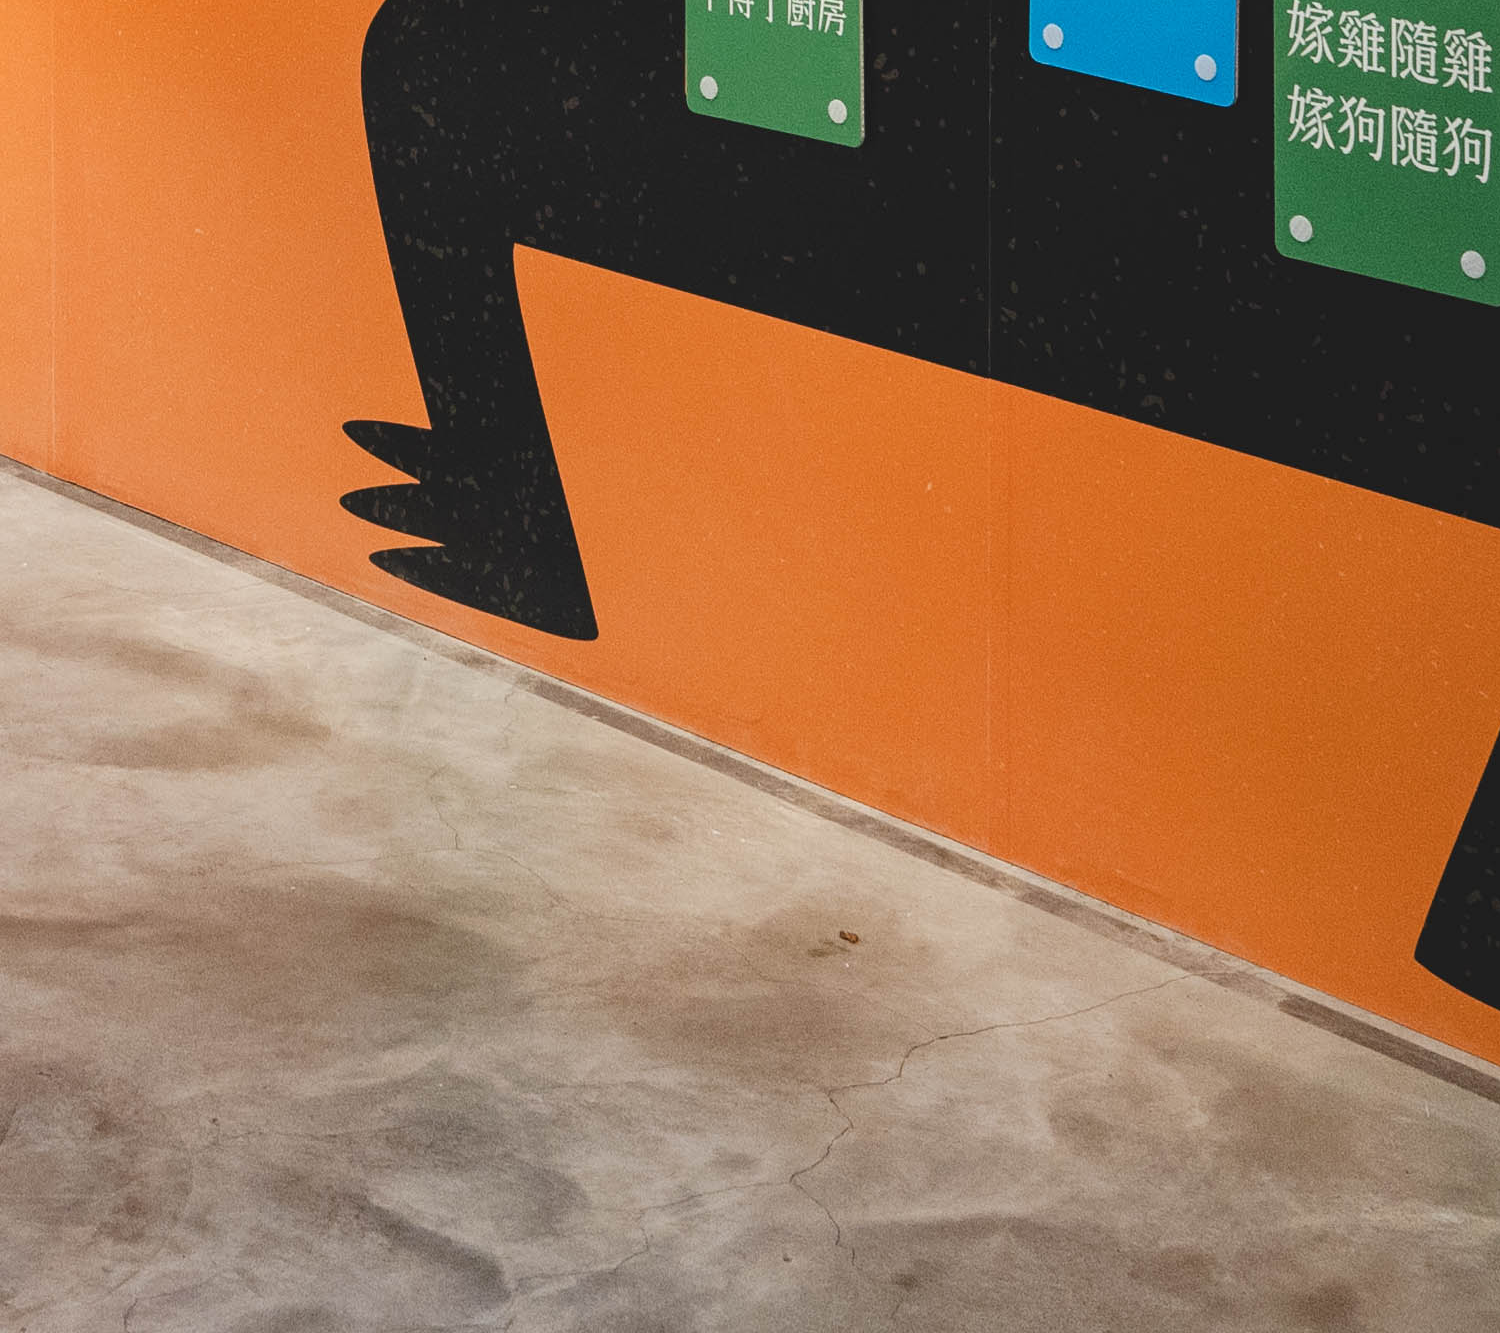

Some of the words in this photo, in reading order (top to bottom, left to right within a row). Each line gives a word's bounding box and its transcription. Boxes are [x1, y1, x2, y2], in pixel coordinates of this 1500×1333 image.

[1287, 0, 1492, 94] 嫁雞隨雞
[1288, 85, 1492, 183] 嫁狗隨狗
